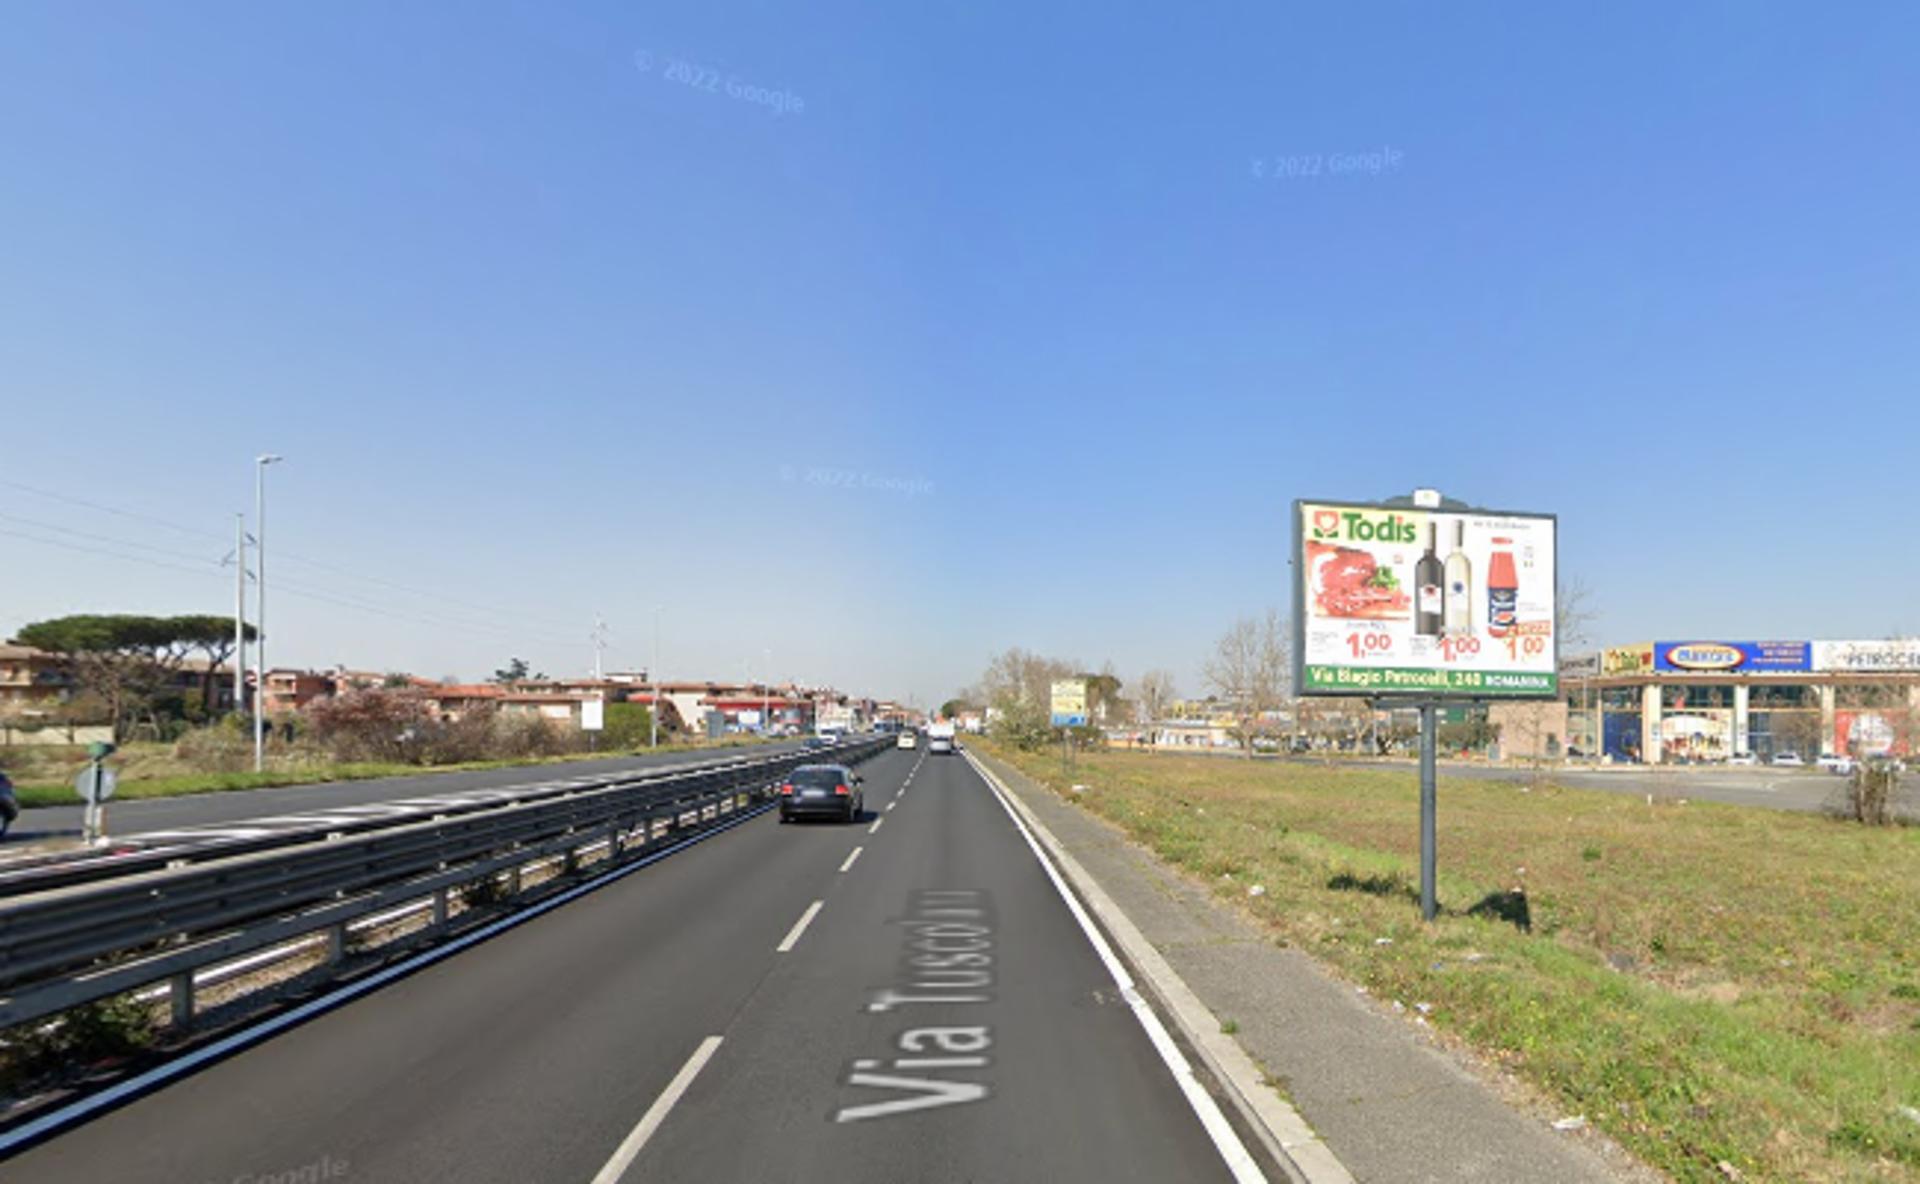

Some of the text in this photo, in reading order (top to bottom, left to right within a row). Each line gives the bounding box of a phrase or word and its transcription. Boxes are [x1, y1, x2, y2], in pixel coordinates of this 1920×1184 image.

[1342, 512, 1416, 543] Todis
[1310, 667, 1333, 682] Via
[1337, 667, 1381, 688] Biagio
